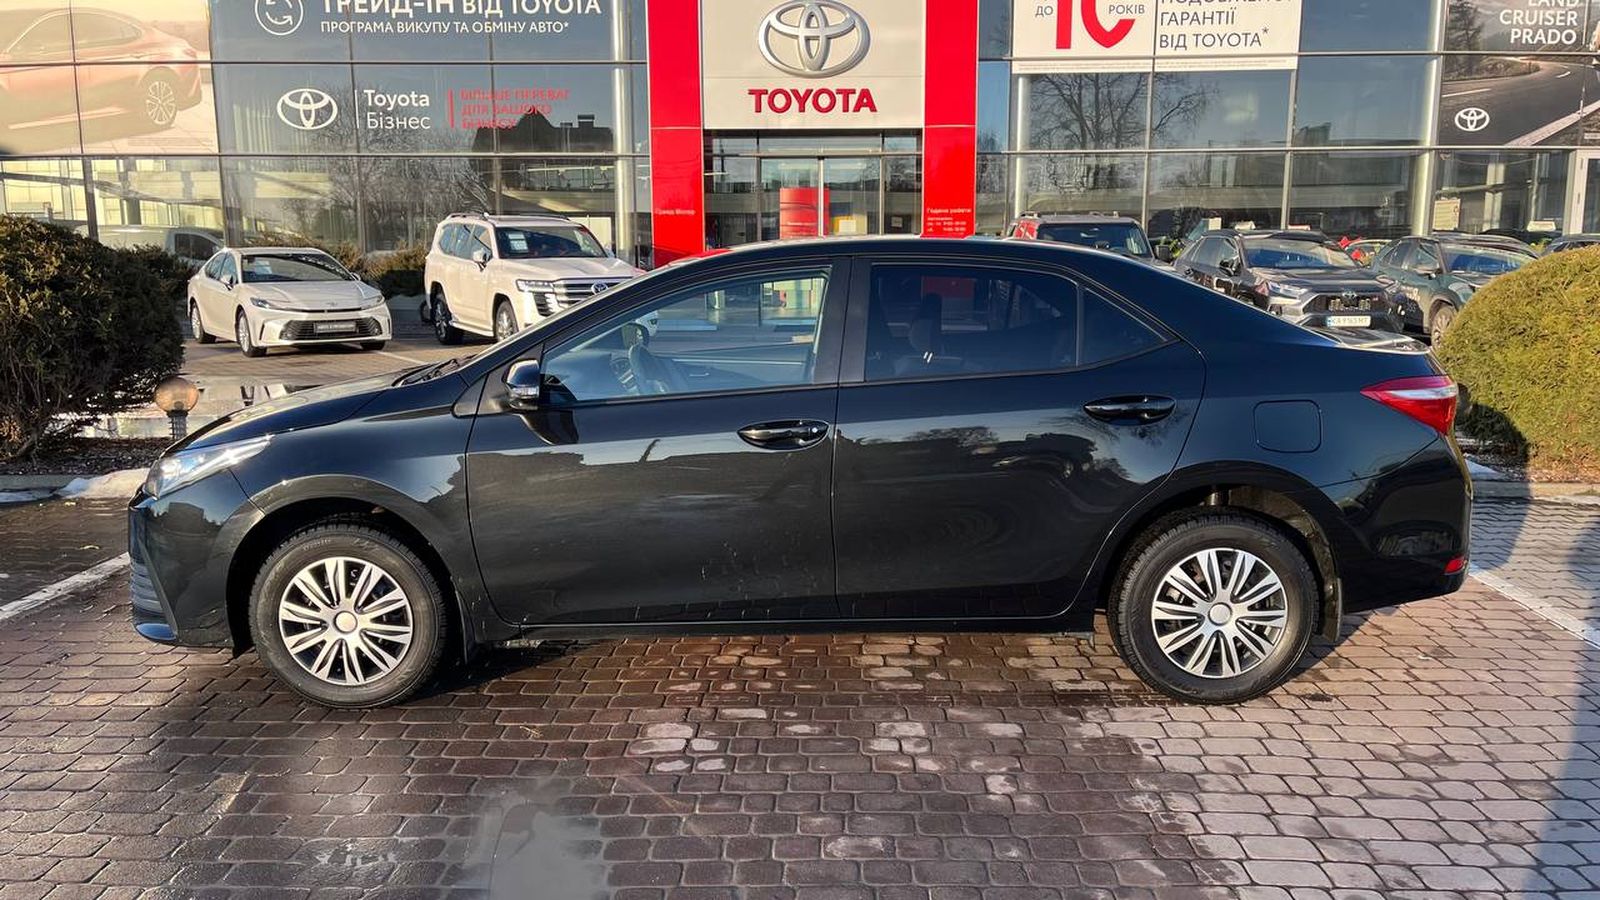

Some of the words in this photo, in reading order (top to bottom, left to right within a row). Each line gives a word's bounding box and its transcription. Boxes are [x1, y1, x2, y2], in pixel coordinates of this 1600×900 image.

[463, 0, 503, 19] ВІД
[1035, 6, 1054, 17] ДО
[1108, 4, 1145, 15] РОКІВ
[1160, 6, 1237, 26] ГАРАНТІЇ
[1499, 9, 1578, 26] CRUISER
[320, 21, 394, 33] ПРОГРАМА
[397, 21, 451, 33] ВИКУПУ
[453, 21, 469, 33] ТА
[472, 21, 526, 33] ОБМІНУ
[1159, 33, 1188, 51] ВІД
[1510, 28, 1577, 45] PRADO
[363, 89, 430, 111] Toyota
[747, 88, 878, 114] TOYOTA
[367, 111, 432, 129] Бізнес
